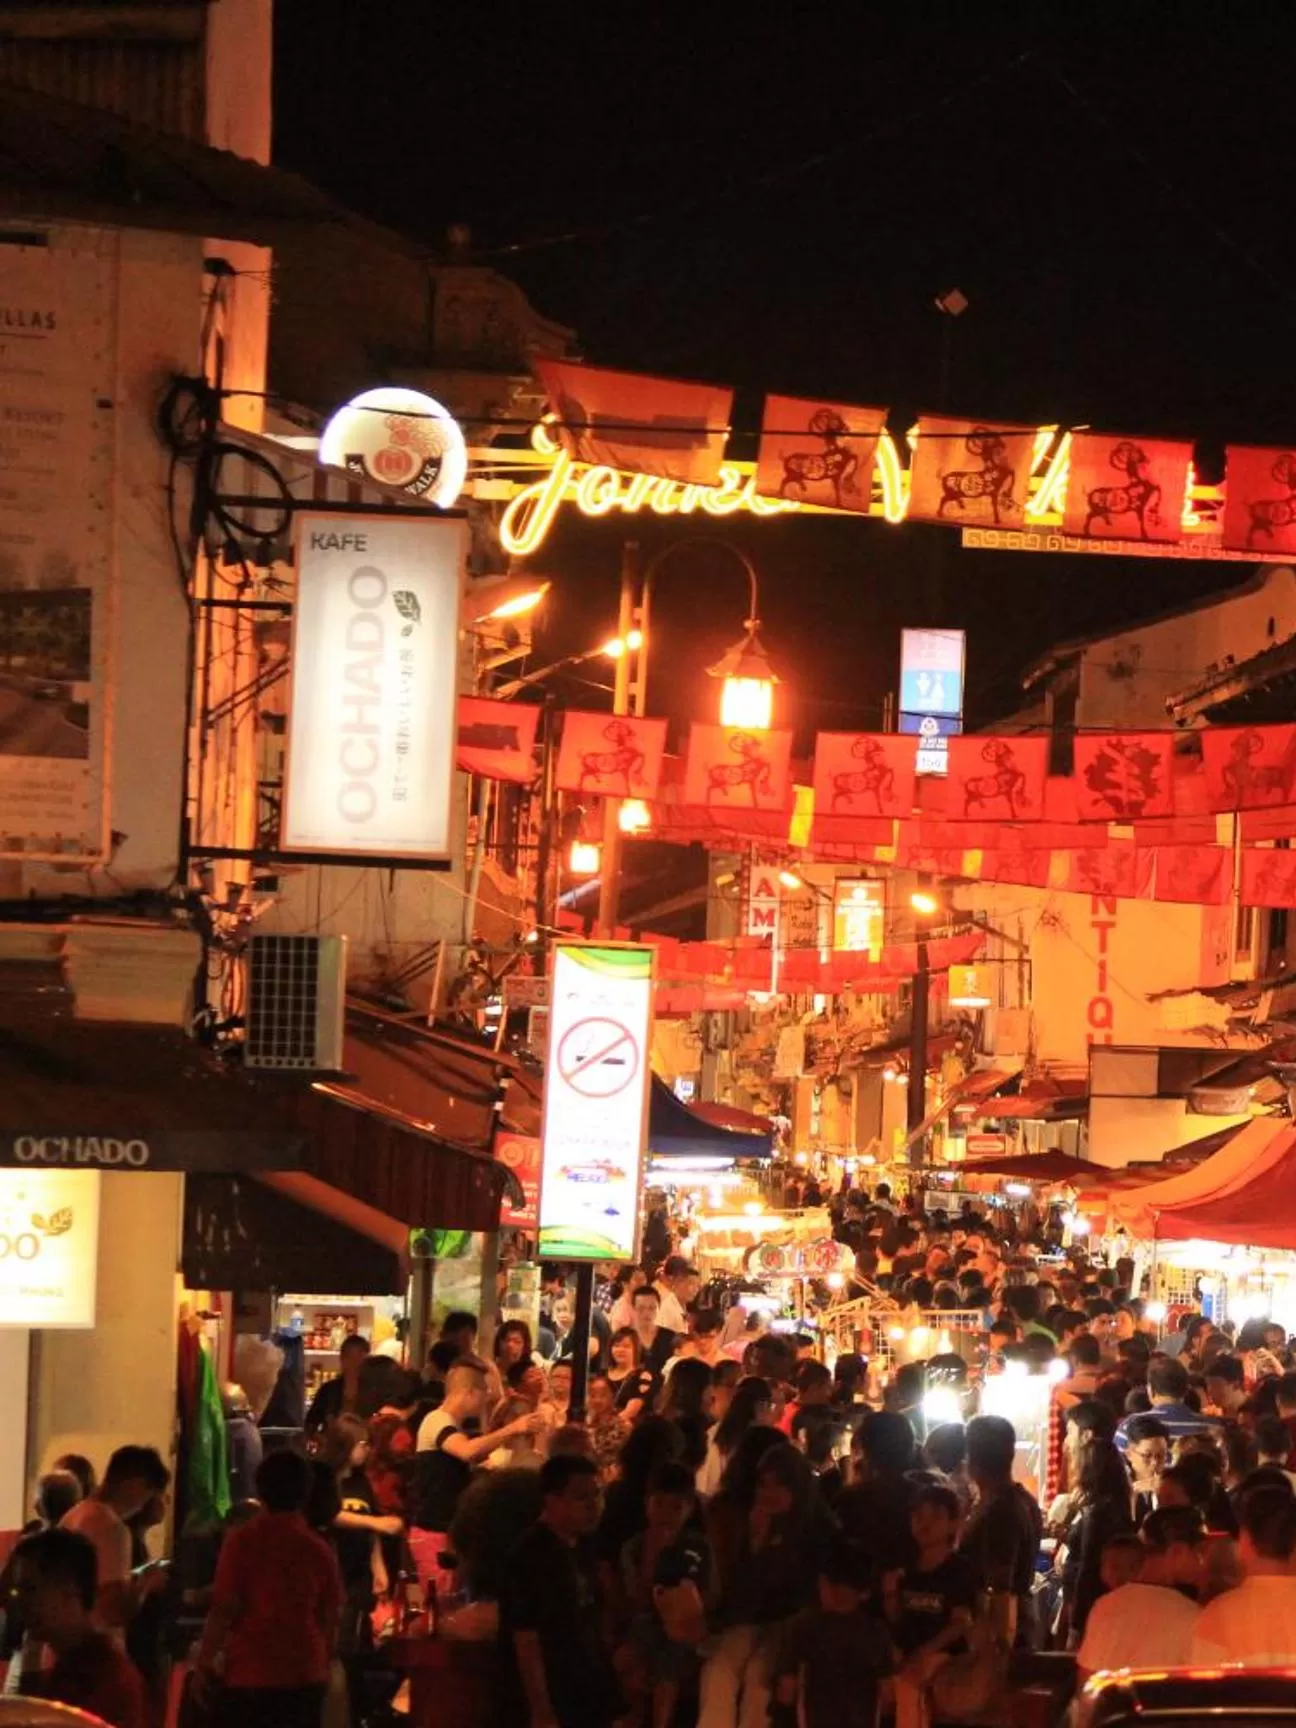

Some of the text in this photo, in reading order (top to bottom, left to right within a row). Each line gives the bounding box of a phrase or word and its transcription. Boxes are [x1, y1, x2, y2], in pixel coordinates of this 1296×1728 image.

[310, 532, 368, 552] KAFE
[336, 564, 389, 824] OCHADO
[13, 1135, 149, 1166] OCHADO
